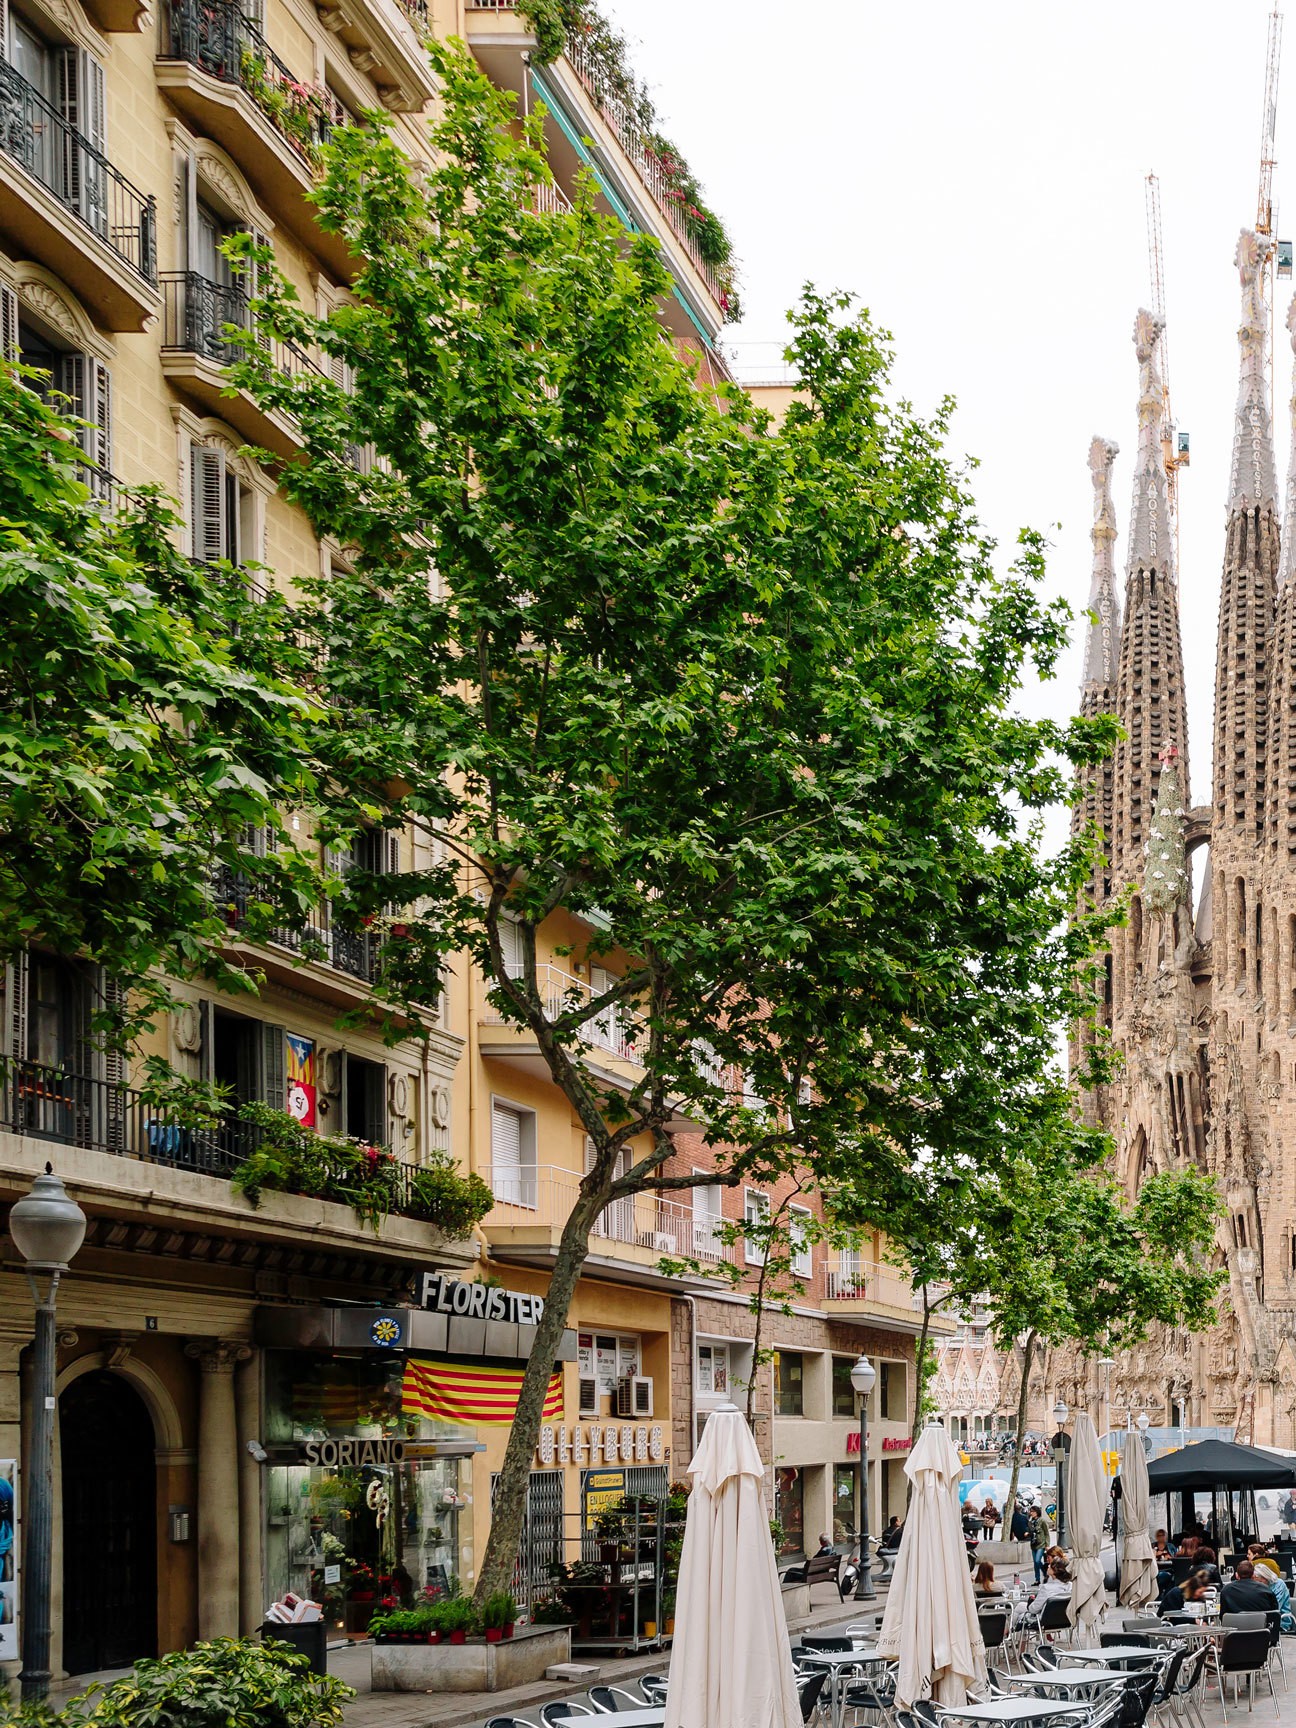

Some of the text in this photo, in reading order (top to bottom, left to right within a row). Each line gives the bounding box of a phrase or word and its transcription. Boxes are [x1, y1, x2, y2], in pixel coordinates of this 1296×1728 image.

[421, 1272, 545, 1326] FLORISTER
[149, 1318, 155, 1329] 6
[305, 1438, 406, 1467] SORIANO
[538, 1425, 663, 1464] OLLYBURG
